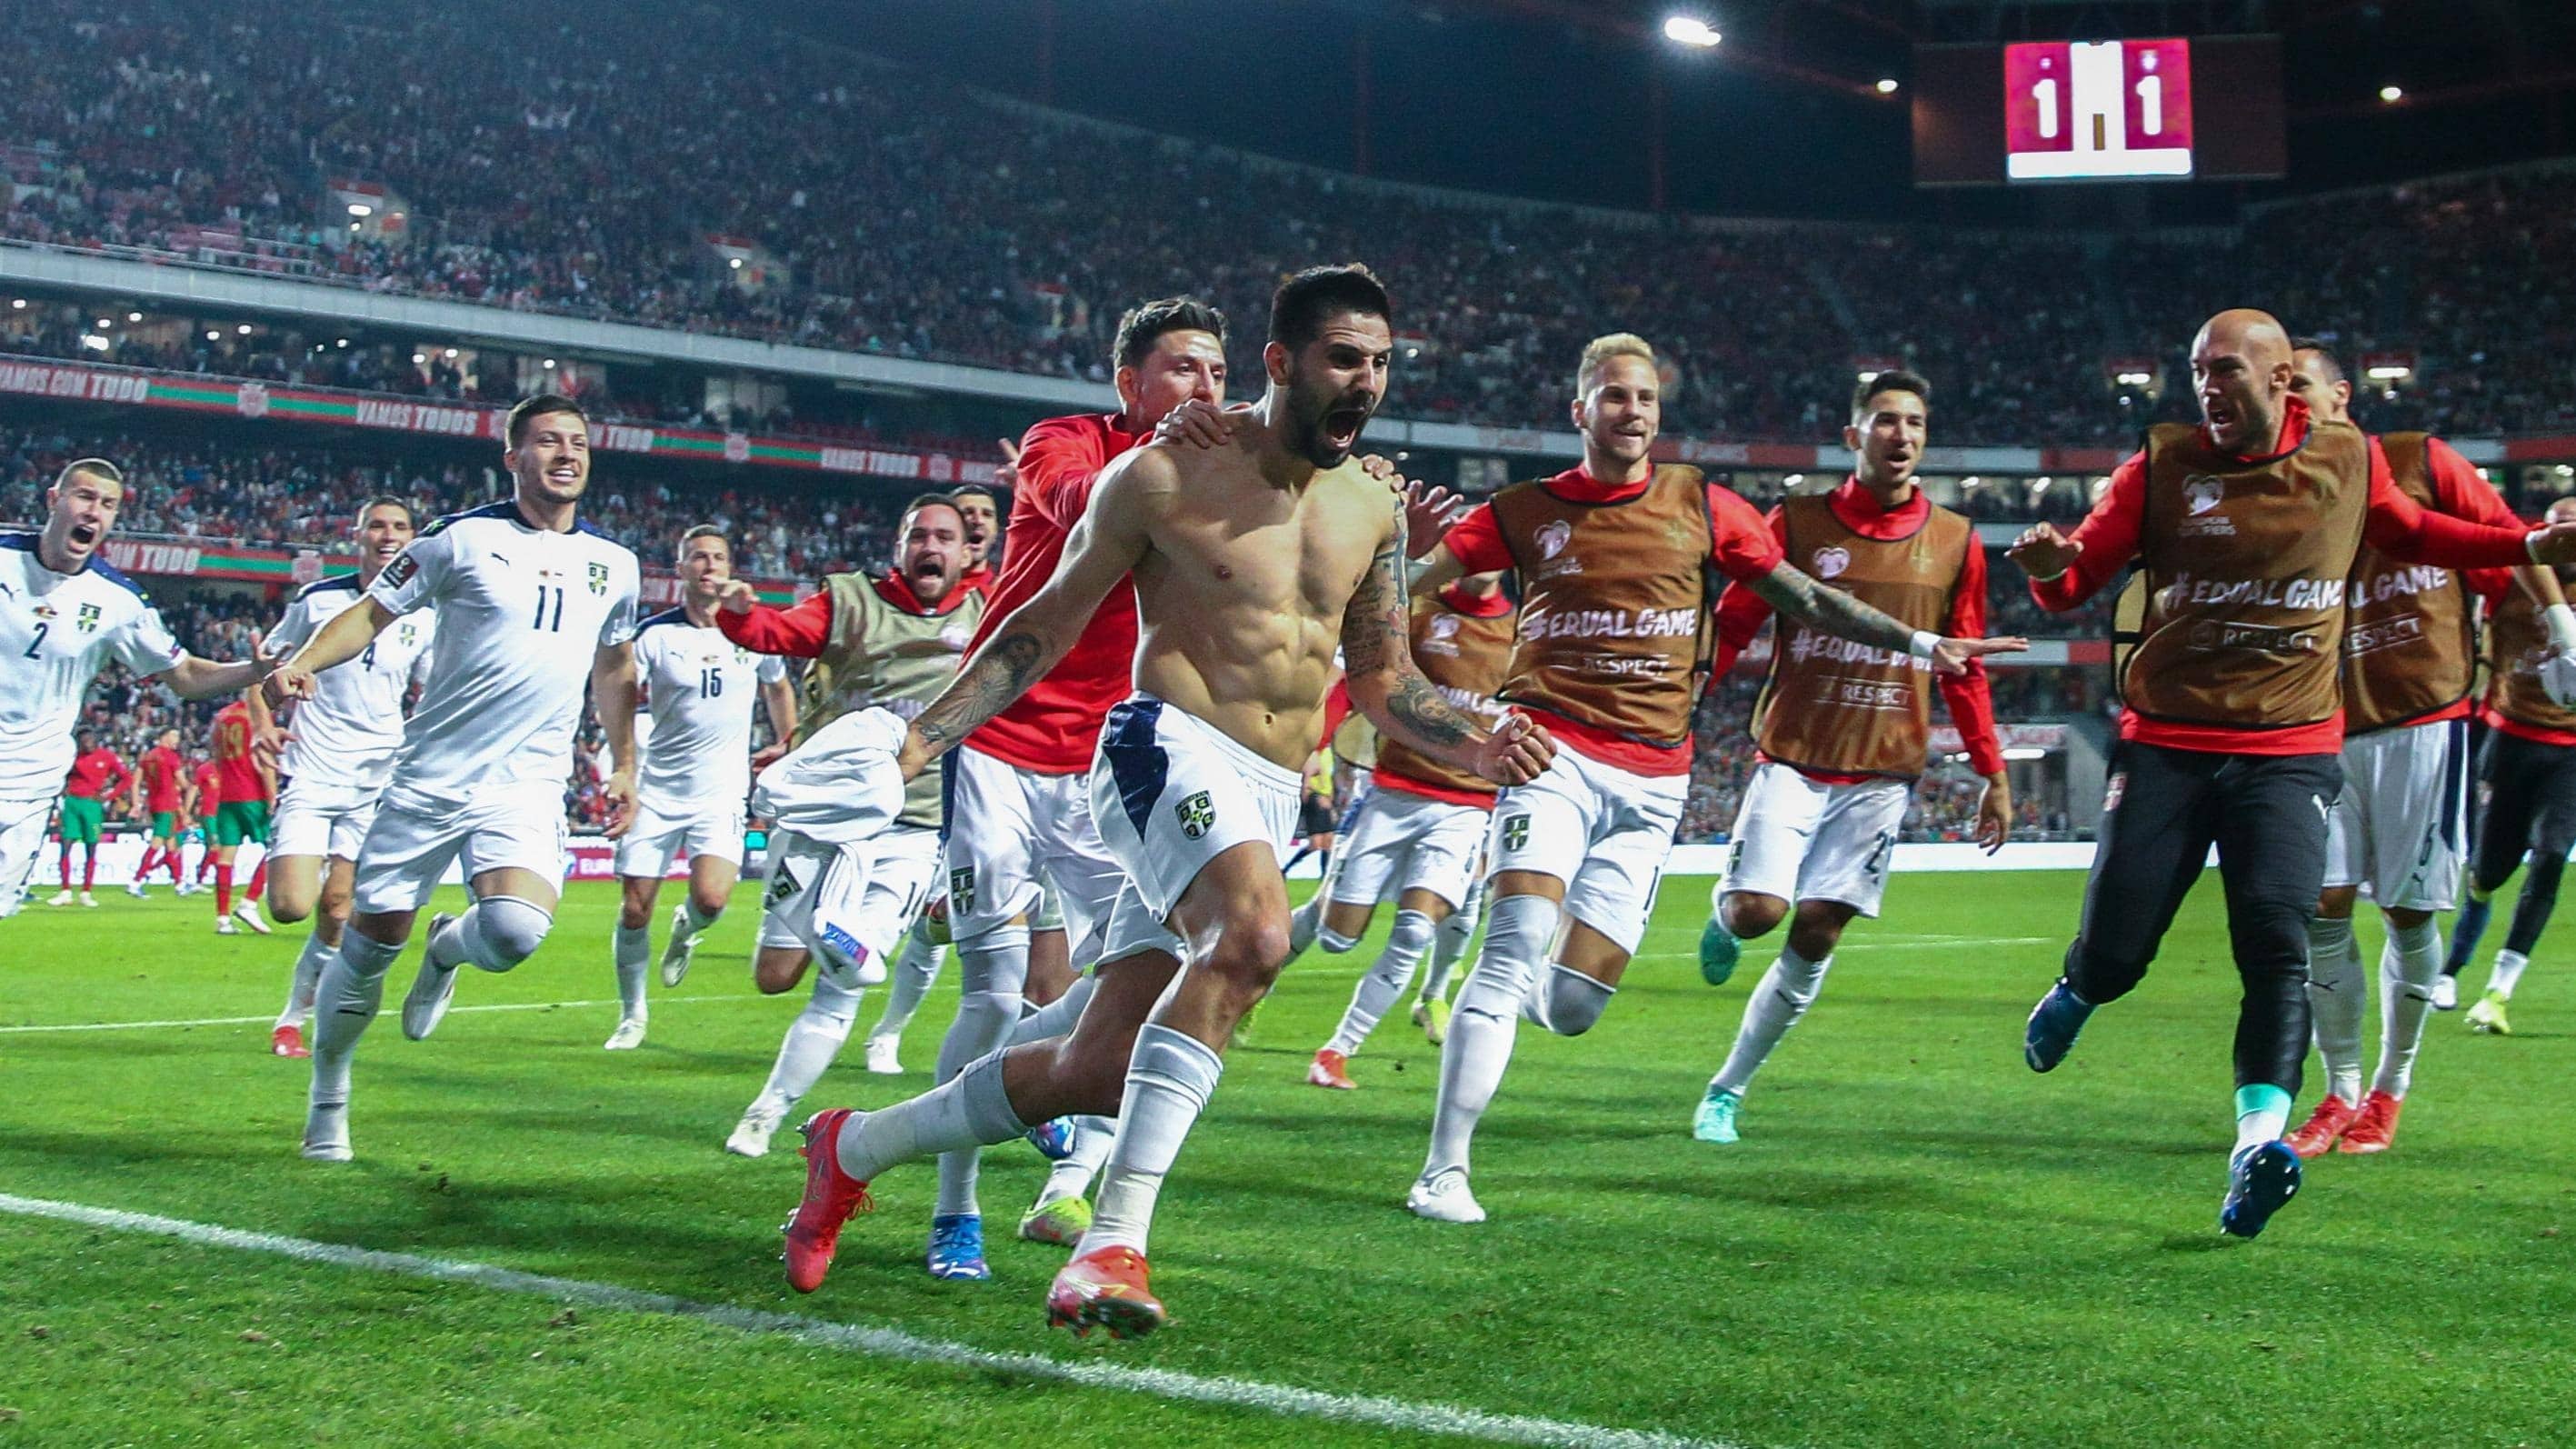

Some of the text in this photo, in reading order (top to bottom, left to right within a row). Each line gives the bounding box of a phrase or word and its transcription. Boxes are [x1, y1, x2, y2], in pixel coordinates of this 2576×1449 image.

[0, 365, 50, 394] AMOS
[90, 373, 150, 403] TUDO
[414, 405, 478, 436] TODOS
[139, 545, 201, 575] TUDO
[2284, 578, 2345, 610] GAM
[2373, 565, 2449, 601] GAME
[533, 585, 563, 633] 11
[1635, 608, 1697, 638] GAME
[23, 622, 49, 660] 2
[360, 641, 376, 672] 4
[701, 667, 723, 699] 15
